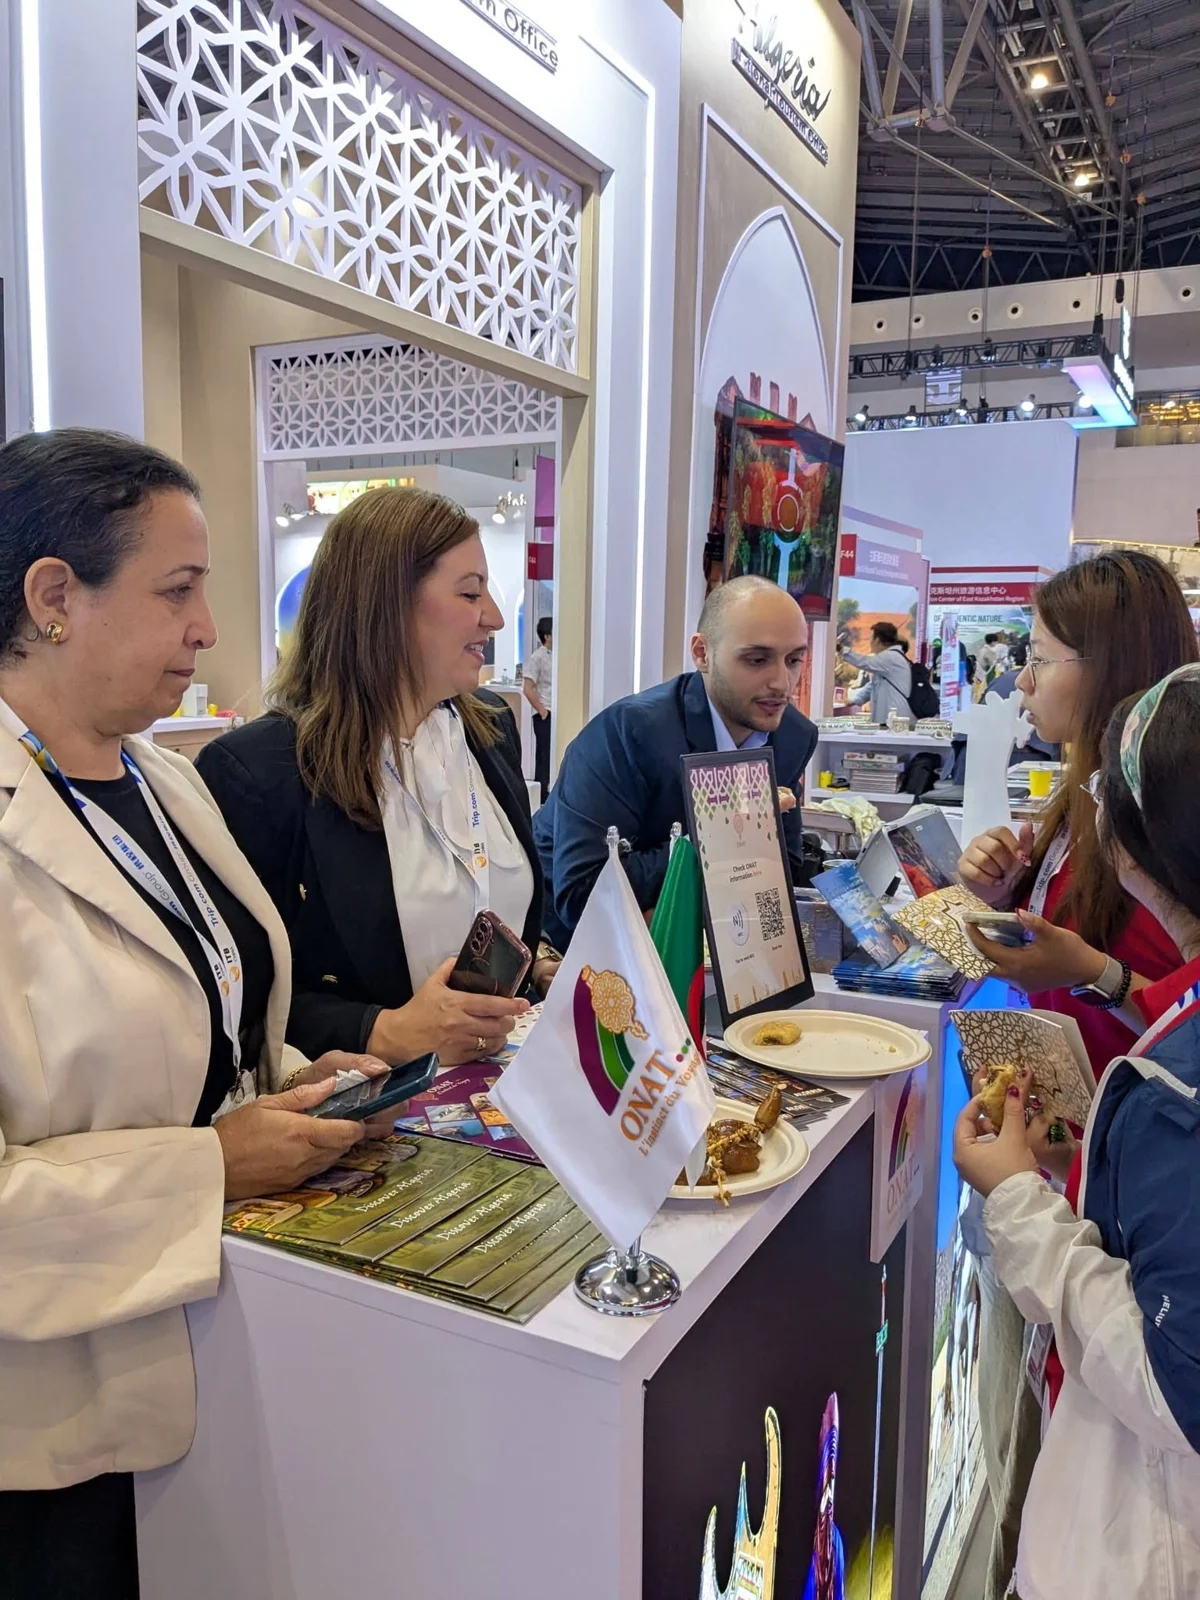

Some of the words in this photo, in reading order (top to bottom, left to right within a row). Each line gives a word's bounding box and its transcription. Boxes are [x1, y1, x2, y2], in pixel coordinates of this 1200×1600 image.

[504, 7, 559, 67] Office
[770, 83, 807, 137] Tourism
[806, 126, 829, 162] Office
[977, 614, 1002, 623] NATURE
[470, 793, 480, 827] Trip.com
[145, 872, 169, 901] Group
[729, 873, 753, 883] information
[732, 864, 746, 874] Check
[1036, 861, 1053, 892] Trip.com
[193, 884, 219, 927] Trip.com
[213, 964, 223, 981] ITB
[222, 947, 233, 964] ITB
[619, 1049, 676, 1142] ONAT
[637, 1101, 671, 1158] L'instinct
[664, 1089, 681, 1108] du
[355, 1191, 398, 1212] Discover
[396, 1167, 434, 1192] Algeria
[390, 1203, 434, 1228] Discover
[432, 1181, 471, 1205] Algeria
[436, 1214, 479, 1240] Discover
[475, 1192, 513, 1217] Algeria
[474, 1226, 515, 1253] Discover
[511, 1202, 547, 1228] Algeria
